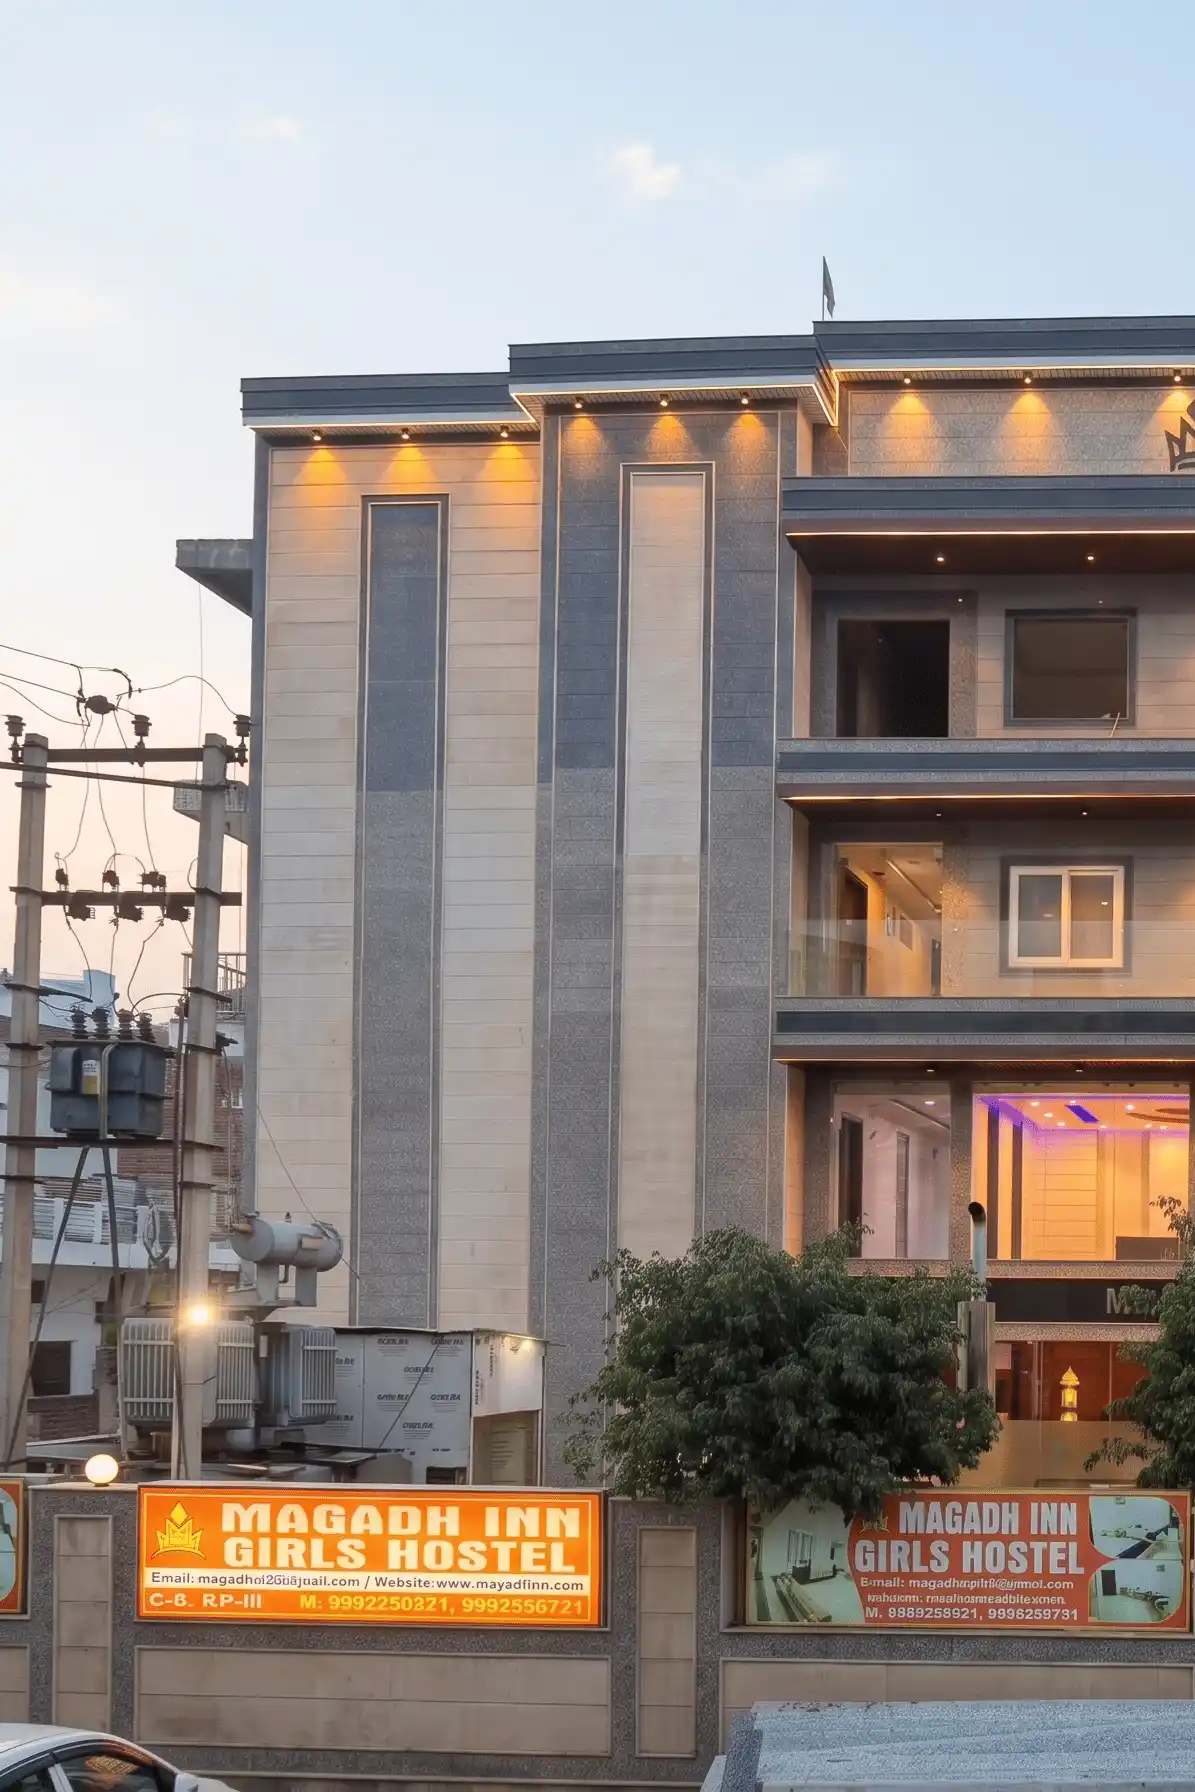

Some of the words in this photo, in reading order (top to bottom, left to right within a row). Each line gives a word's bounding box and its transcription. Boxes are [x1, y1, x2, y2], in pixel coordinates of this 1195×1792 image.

[221, 1502, 460, 1537] MAGADH
[485, 1506, 580, 1538] INN
[899, 1501, 1019, 1535] MAGADH
[1031, 1502, 1077, 1535] INN
[223, 1537, 366, 1569] GIRLS
[387, 1540, 575, 1572] HOSTEL
[854, 1540, 950, 1573] GIRLS
[962, 1541, 1085, 1574] HOSTEL
[151, 1571, 194, 1584] Email:
